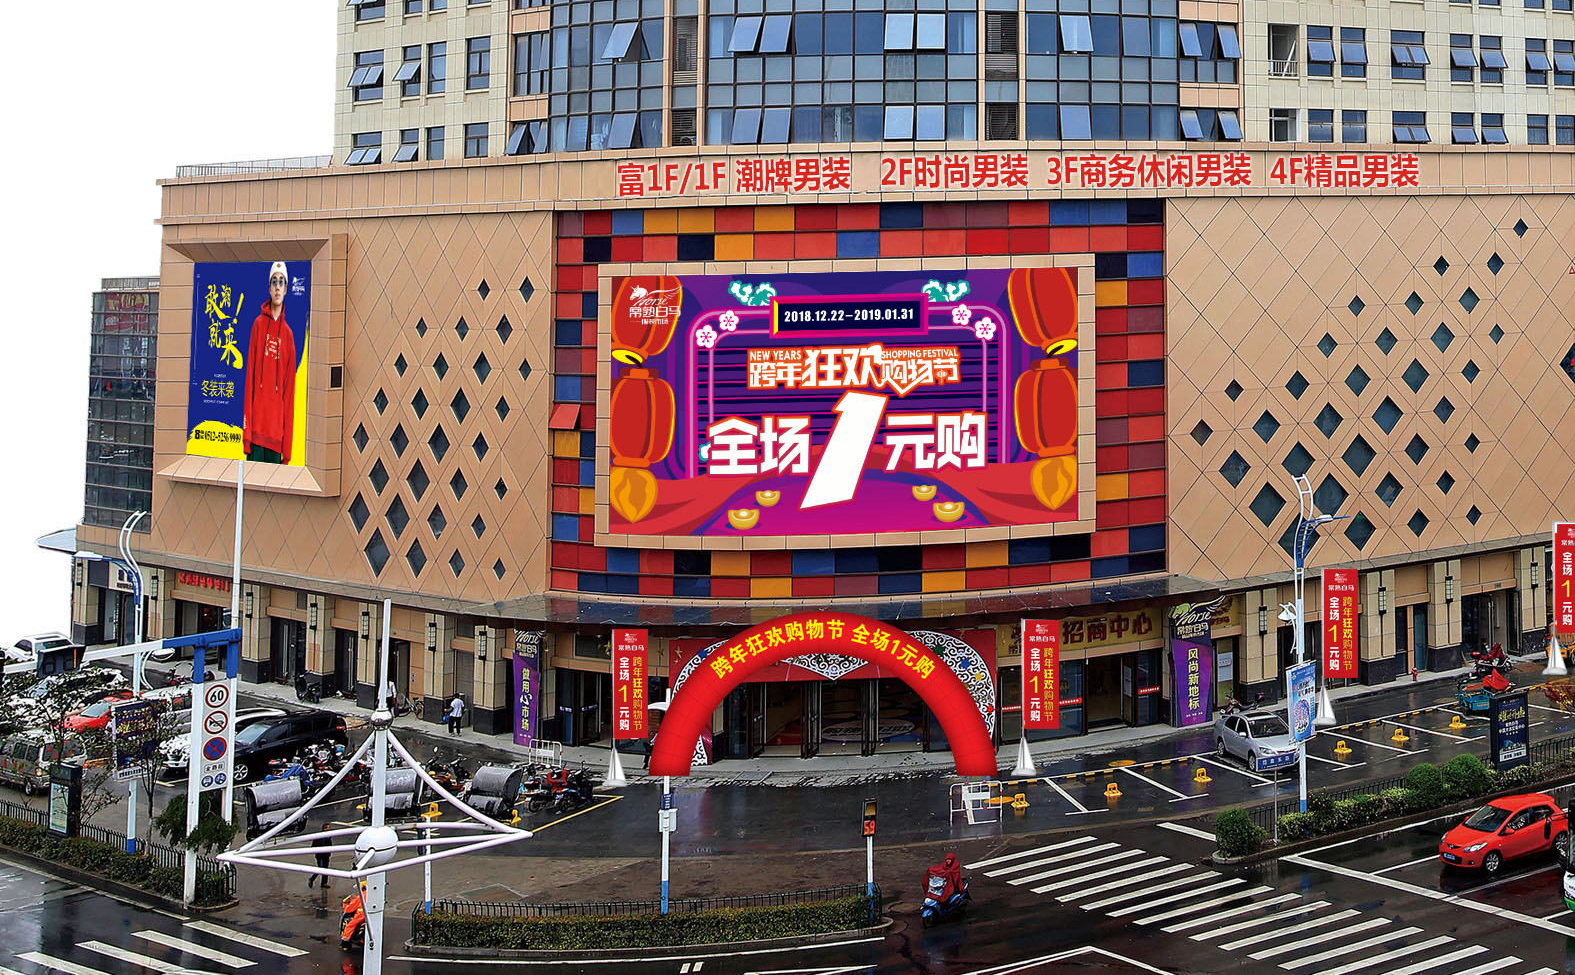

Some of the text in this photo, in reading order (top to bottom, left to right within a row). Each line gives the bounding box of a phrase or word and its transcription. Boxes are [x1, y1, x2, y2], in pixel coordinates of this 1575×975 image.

[617, 154, 1420, 196] 富1F/1F 潮牌男装 2F时尚男装 3F商务休闲男装 4F精品男装
[749, 344, 960, 397] 跨年狂欢购物节
[750, 347, 959, 361] NEW YEARS SHOPPING FESTIVAL
[201, 379, 235, 399] 冬装来袭
[708, 392, 986, 508] 全场1元购
[1328, 584, 1355, 592] 常熟白马
[1562, 551, 1573, 626] 全场1元购
[617, 644, 645, 652] 常熟白马
[709, 620, 937, 680] 跨年狂欢购物节 全场1元购
[1062, 612, 1153, 645] 招商中心
[1328, 596, 1340, 671] 全场1元购
[1342, 596, 1353, 672] 跨年狂欢购物节
[210, 689, 223, 702] 60
[618, 656, 630, 731] 全场1元购
[632, 656, 643, 731] 跨年狂欢购物节
[1029, 647, 1041, 722] 全场1元购
[1043, 647, 1054, 723] 跨年狂欢购物节
[1187, 647, 1200, 710] 风尚新地标
